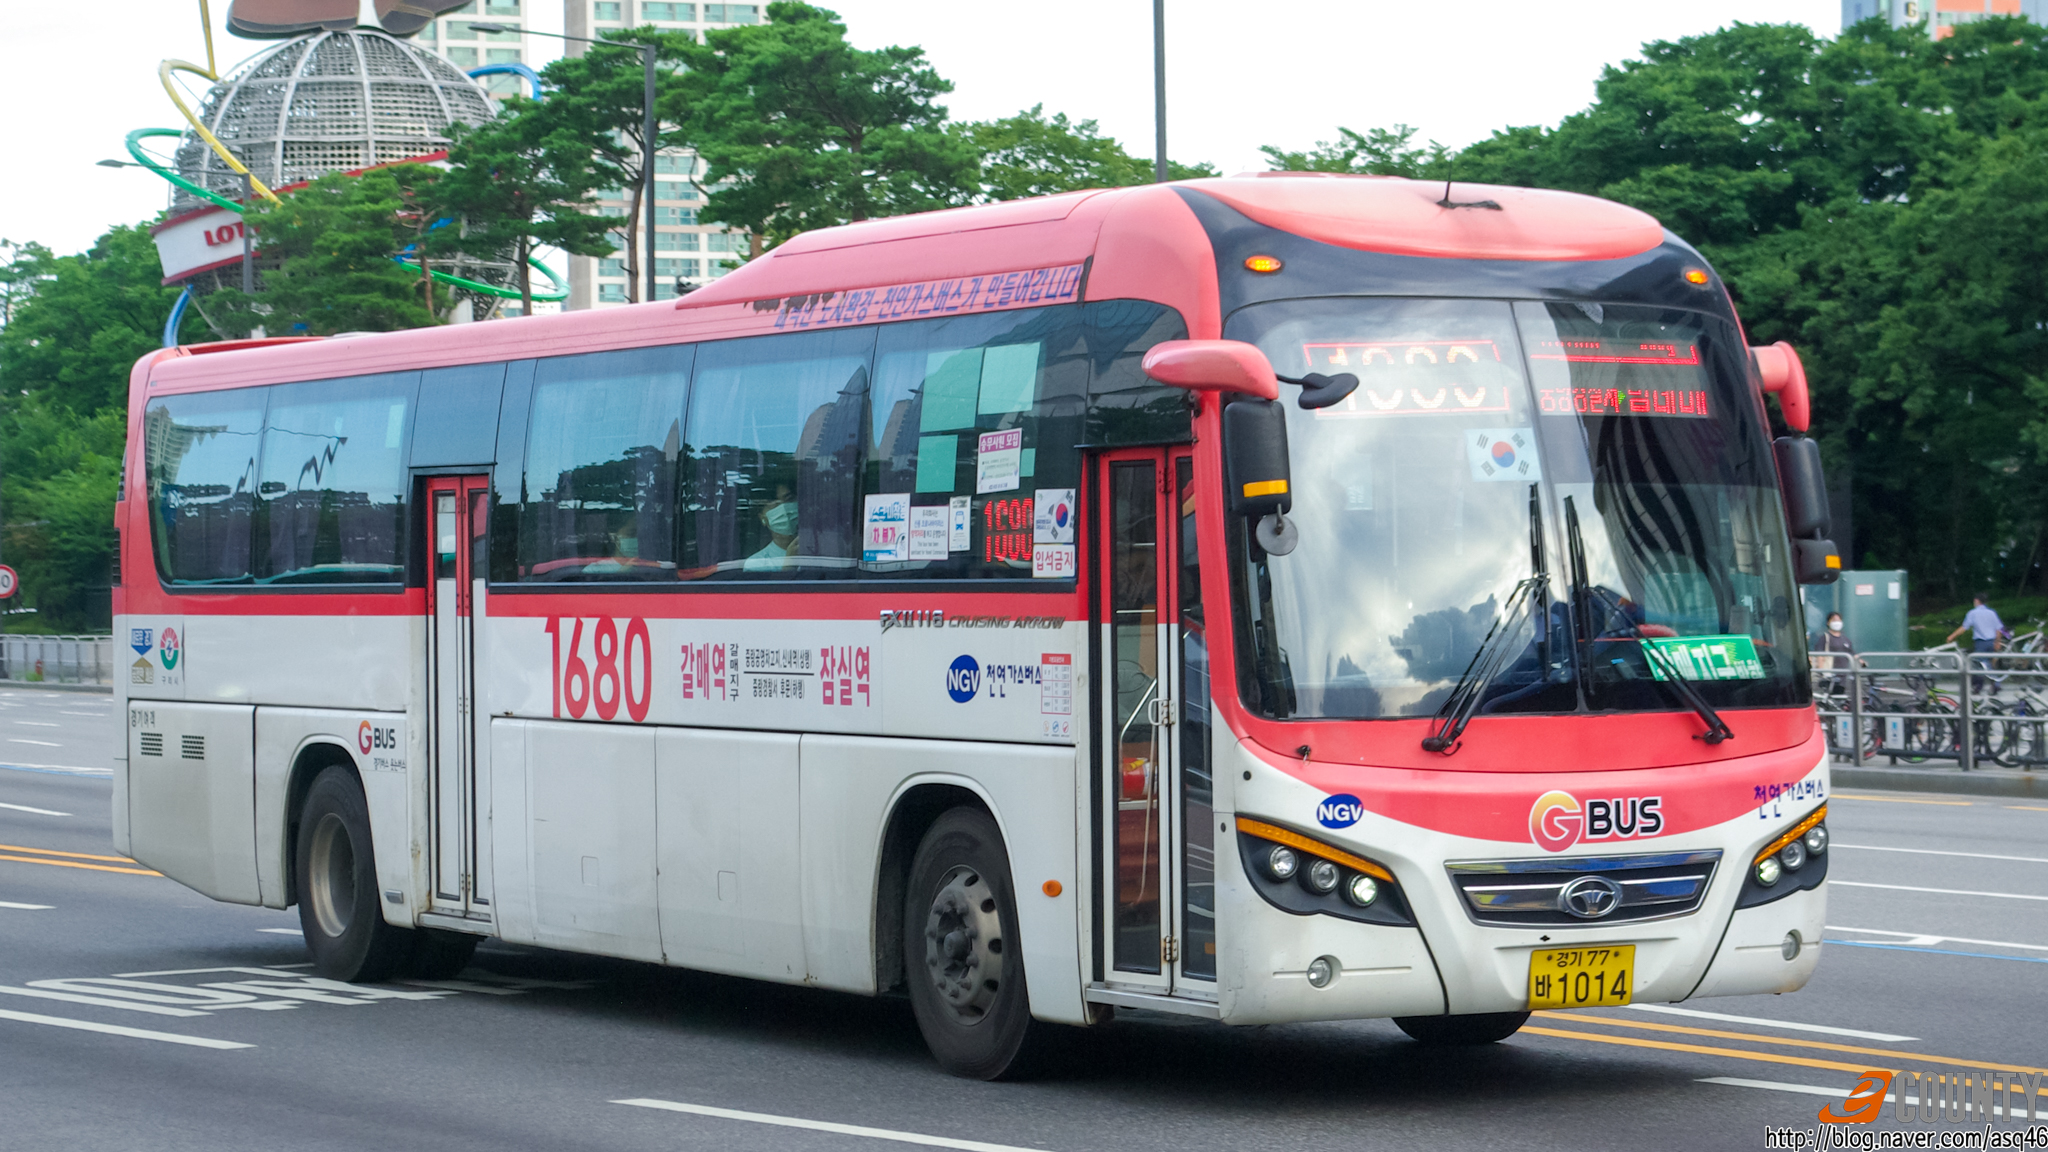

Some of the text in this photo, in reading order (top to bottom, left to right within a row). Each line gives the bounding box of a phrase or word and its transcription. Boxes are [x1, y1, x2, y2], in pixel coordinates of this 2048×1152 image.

[1035, 550, 1073, 571] 입석금지
[948, 615, 1011, 629] CRUISING
[1012, 616, 1066, 629] ARROW
[544, 614, 652, 723] 1680
[680, 642, 725, 701] 갈매역
[729, 643, 739, 702] 갈매지구
[820, 645, 870, 707] 잠실역
[948, 667, 980, 695] NGV
[986, 664, 1042, 698] 천연가스버스
[373, 727, 396, 749] BUS
[1317, 802, 1362, 822] NGV
[1754, 779, 1824, 820] 천연가스버스
[1586, 796, 1664, 839] BUS
[1556, 950, 1610, 968] 경기 77
[1535, 969, 1627, 1004] 바 1014
